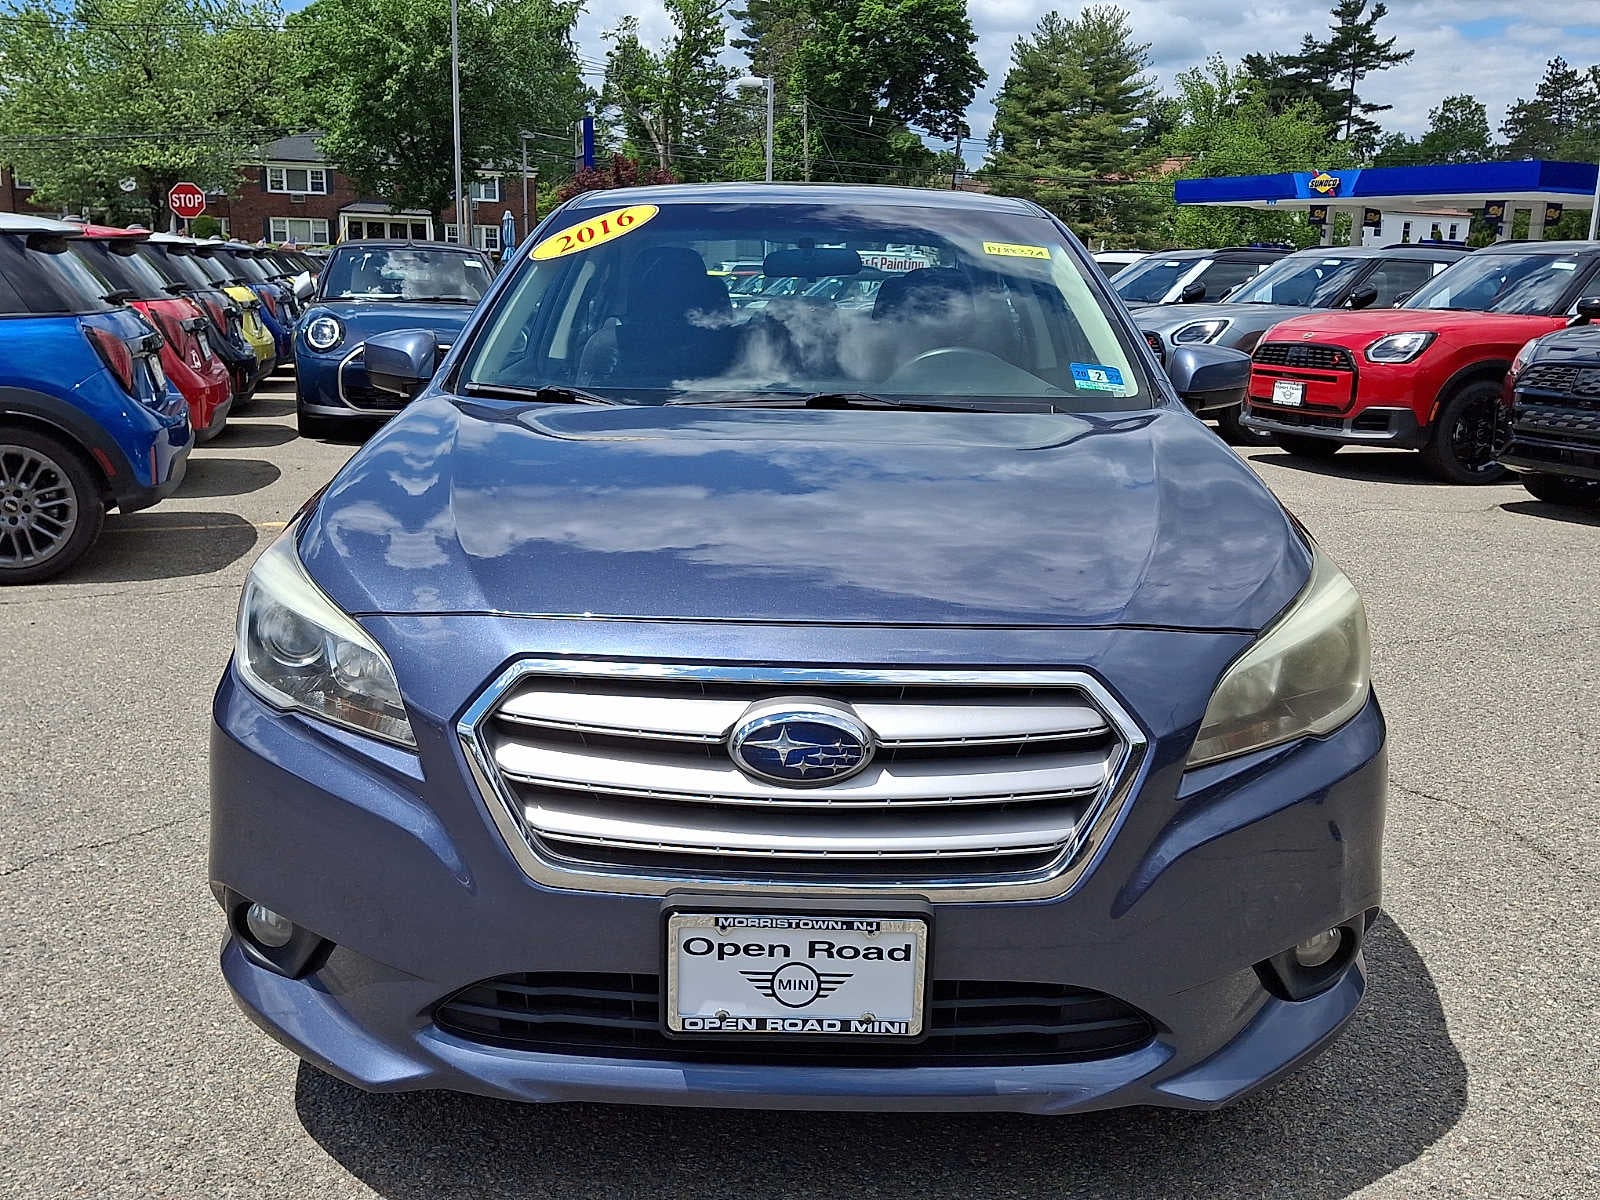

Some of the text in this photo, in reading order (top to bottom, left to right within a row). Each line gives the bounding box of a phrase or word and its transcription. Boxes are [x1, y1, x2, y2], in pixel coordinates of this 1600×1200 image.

[1309, 179, 1339, 188] SUNOCO
[171, 194, 203, 208] STOP
[557, 210, 635, 253] 2016
[880, 257, 925, 270] Painting
[1095, 372, 1103, 380] 2
[853, 922, 878, 932] NJ
[682, 936, 912, 962] Open Road
[777, 978, 815, 992] MINI
[684, 1018, 907, 1034] OPEN ROAD MINI
